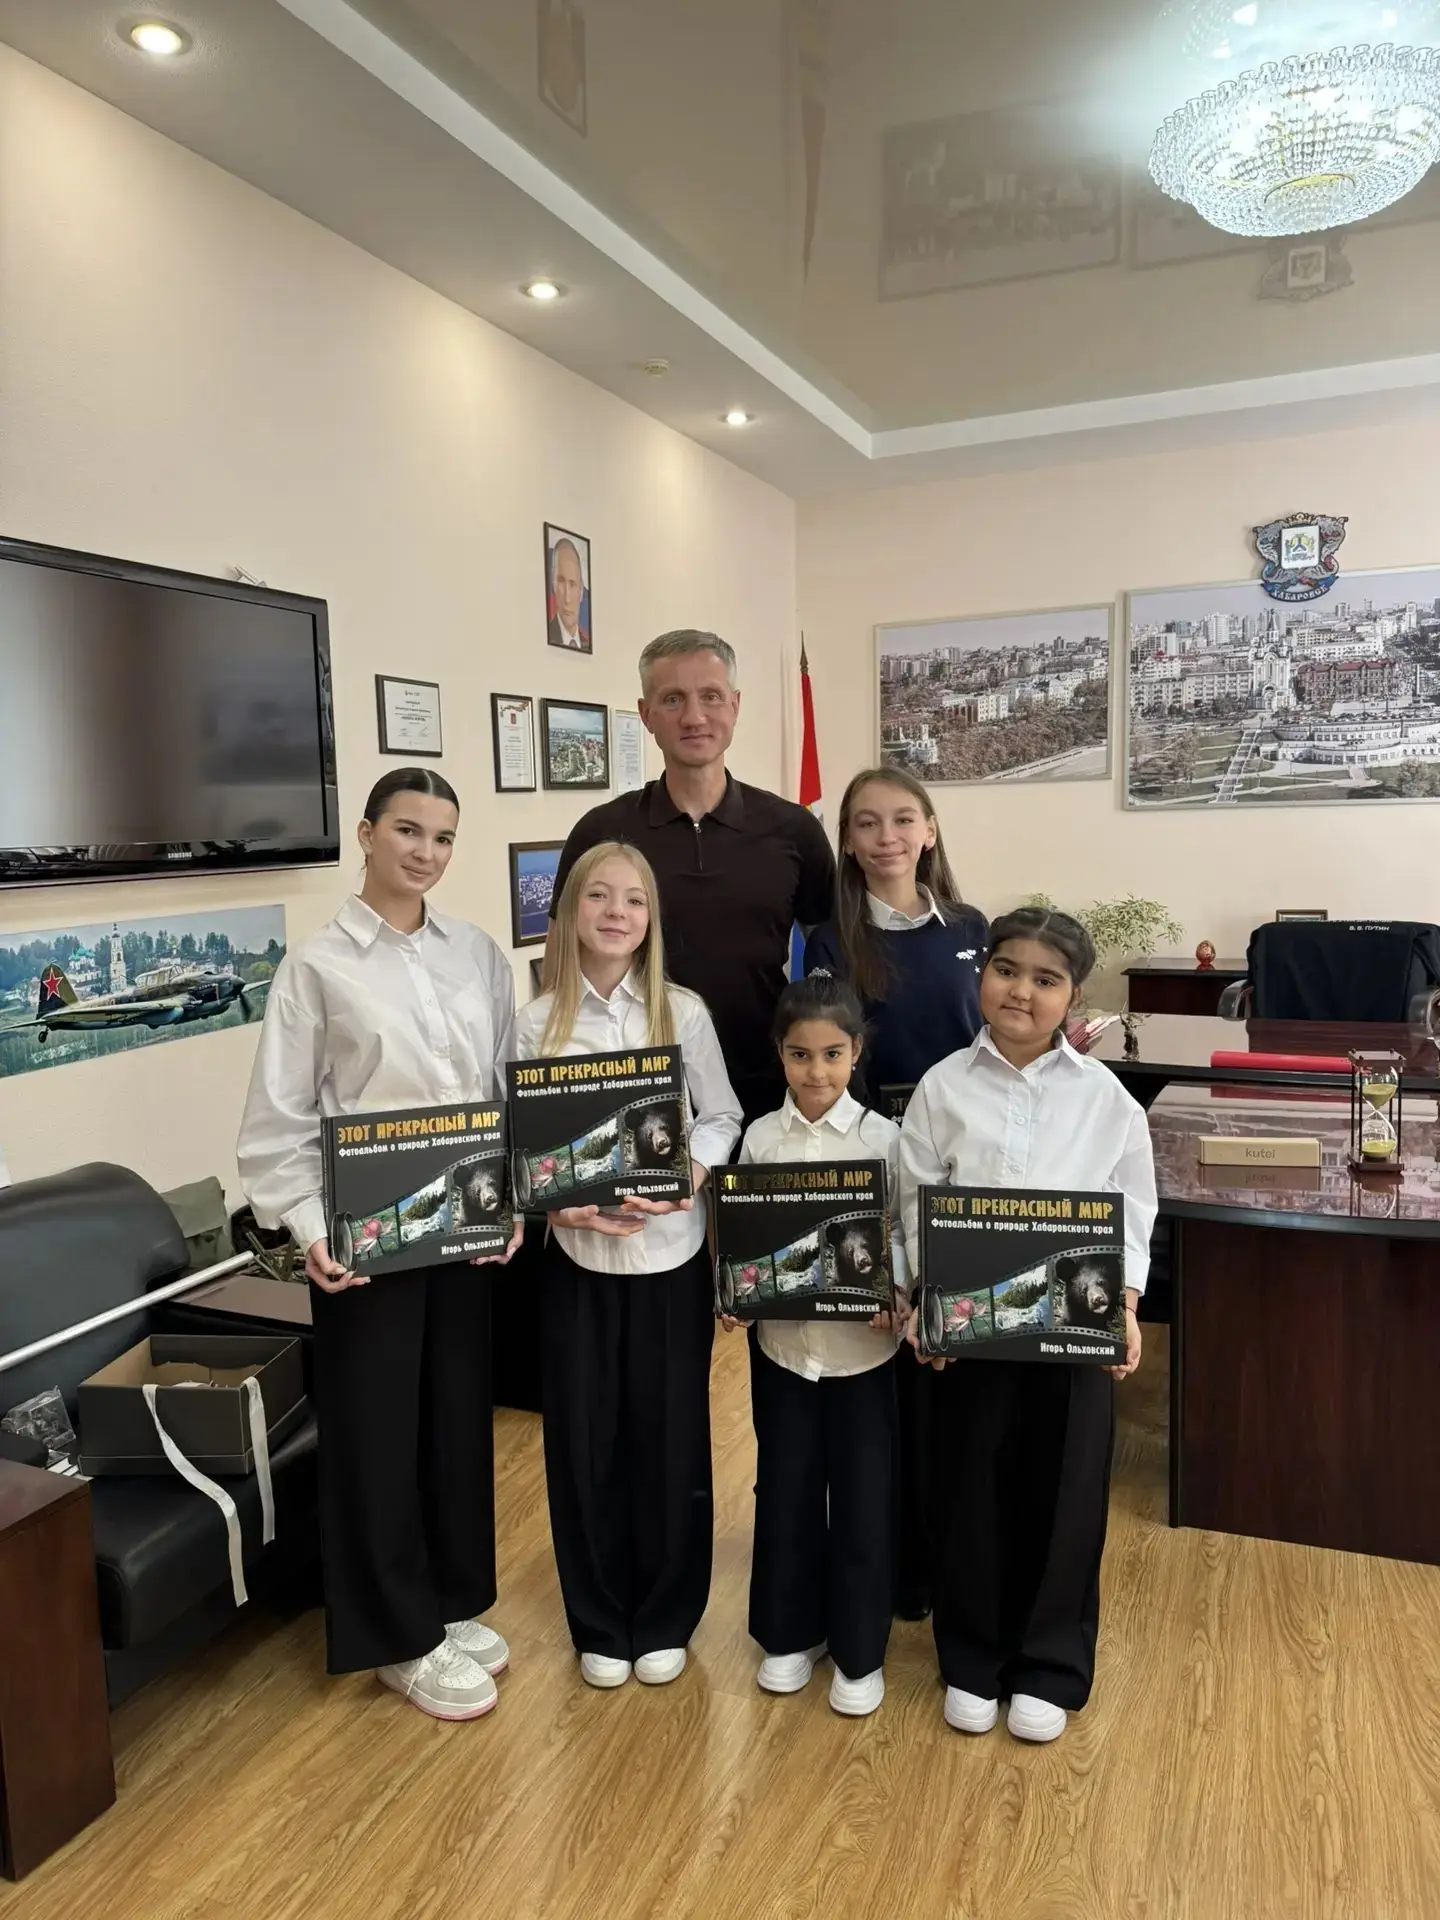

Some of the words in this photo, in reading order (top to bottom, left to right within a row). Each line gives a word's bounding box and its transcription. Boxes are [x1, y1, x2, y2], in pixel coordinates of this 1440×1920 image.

[1274, 584, 1328, 600] ХАБАРОВСК
[515, 1068, 545, 1085] ЭТОТ
[550, 1057, 636, 1082] ПРЕКРАСНЫЙ
[642, 1056, 671, 1073] МИР
[516, 1085, 561, 1098] Фотоальбом
[564, 1086, 568, 1094] о
[570, 1082, 600, 1093] природе
[602, 1077, 652, 1090] Хабаровского
[654, 1075, 672, 1085] края
[337, 1124, 371, 1144] ЭТОТ
[376, 1112, 467, 1139] ПРЕКРАСНЫЙ
[471, 1111, 500, 1129] МИР
[338, 1144, 388, 1158] Фотоальбом
[391, 1143, 396, 1151] о
[398, 1140, 429, 1152] природе
[432, 1134, 481, 1147] Хабаровского
[483, 1132, 501, 1141] края
[753, 1169, 838, 1189] ПРЕКРАСНЫЙ
[843, 1170, 873, 1187] МИР
[615, 1187, 635, 1196] Игорь
[637, 1182, 679, 1194] Ольховский
[721, 1194, 764, 1203] Фотоальбом
[773, 1193, 802, 1203] природе
[804, 1192, 853, 1202] Хабаровского
[856, 1192, 874, 1201] края
[930, 1196, 965, 1215] ЭТОТ
[971, 1197, 1073, 1218] ПРЕКРАСНЫЙ
[1078, 1202, 1113, 1219] МИР
[931, 1217, 983, 1230] Фотоальбом
[986, 1222, 991, 1230] о
[994, 1221, 1029, 1232] природе
[1031, 1221, 1090, 1234] Хабаровского
[1093, 1225, 1114, 1235] края
[441, 1245, 462, 1255] Игорь
[464, 1236, 504, 1251] Ольховский
[815, 1302, 836, 1312] Игорь
[838, 1301, 880, 1312] Ольховский
[1040, 1342, 1064, 1354] Игорь
[1066, 1343, 1115, 1355] Ольховский
